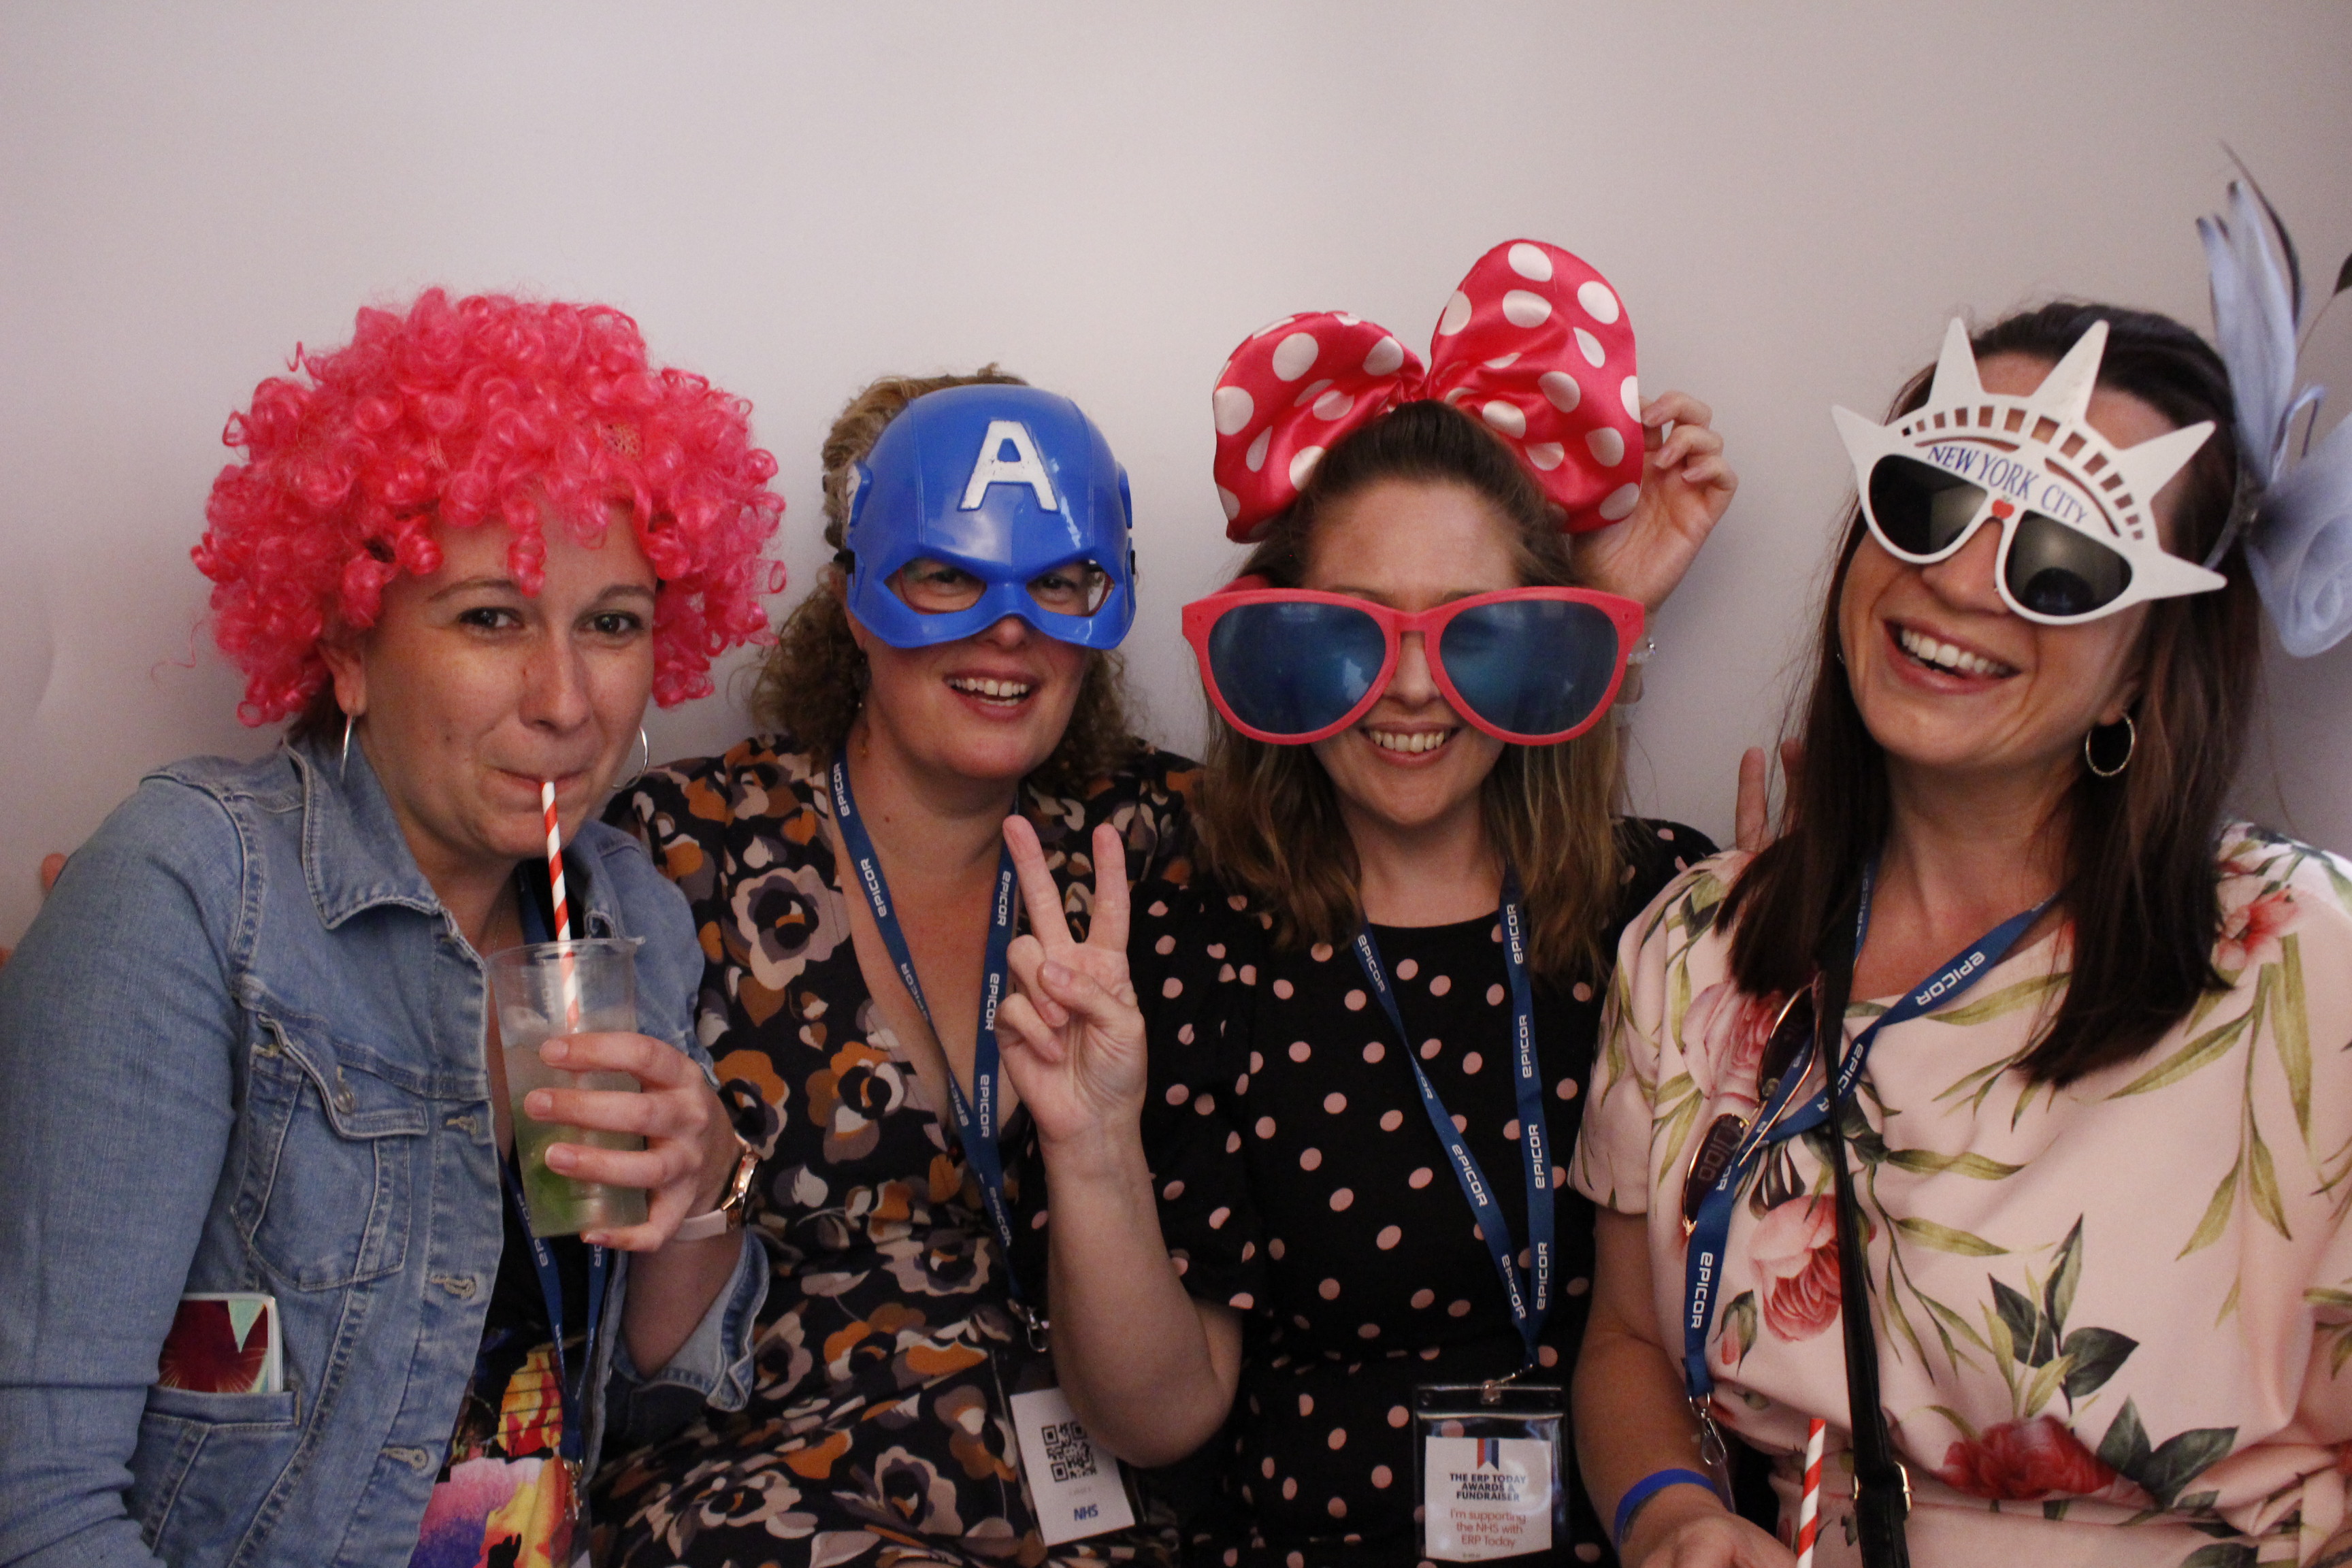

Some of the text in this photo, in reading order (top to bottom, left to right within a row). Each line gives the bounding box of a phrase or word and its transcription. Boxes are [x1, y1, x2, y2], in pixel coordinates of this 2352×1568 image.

[960, 419, 1059, 511] A
[1927, 446, 2087, 523] NEW YORK CITY
[1450, 1473, 1526, 1484] THE ERP TODAY
[1462, 1483, 1504, 1492] AWARDS
[1456, 1491, 1520, 1501] FUNDRAISER
[1074, 1503, 1098, 1521] NHS
[1450, 1508, 1526, 1524] I'm supporting
[1456, 1522, 1522, 1534] the NHS with
[1461, 1534, 1516, 1549] ERP Today
